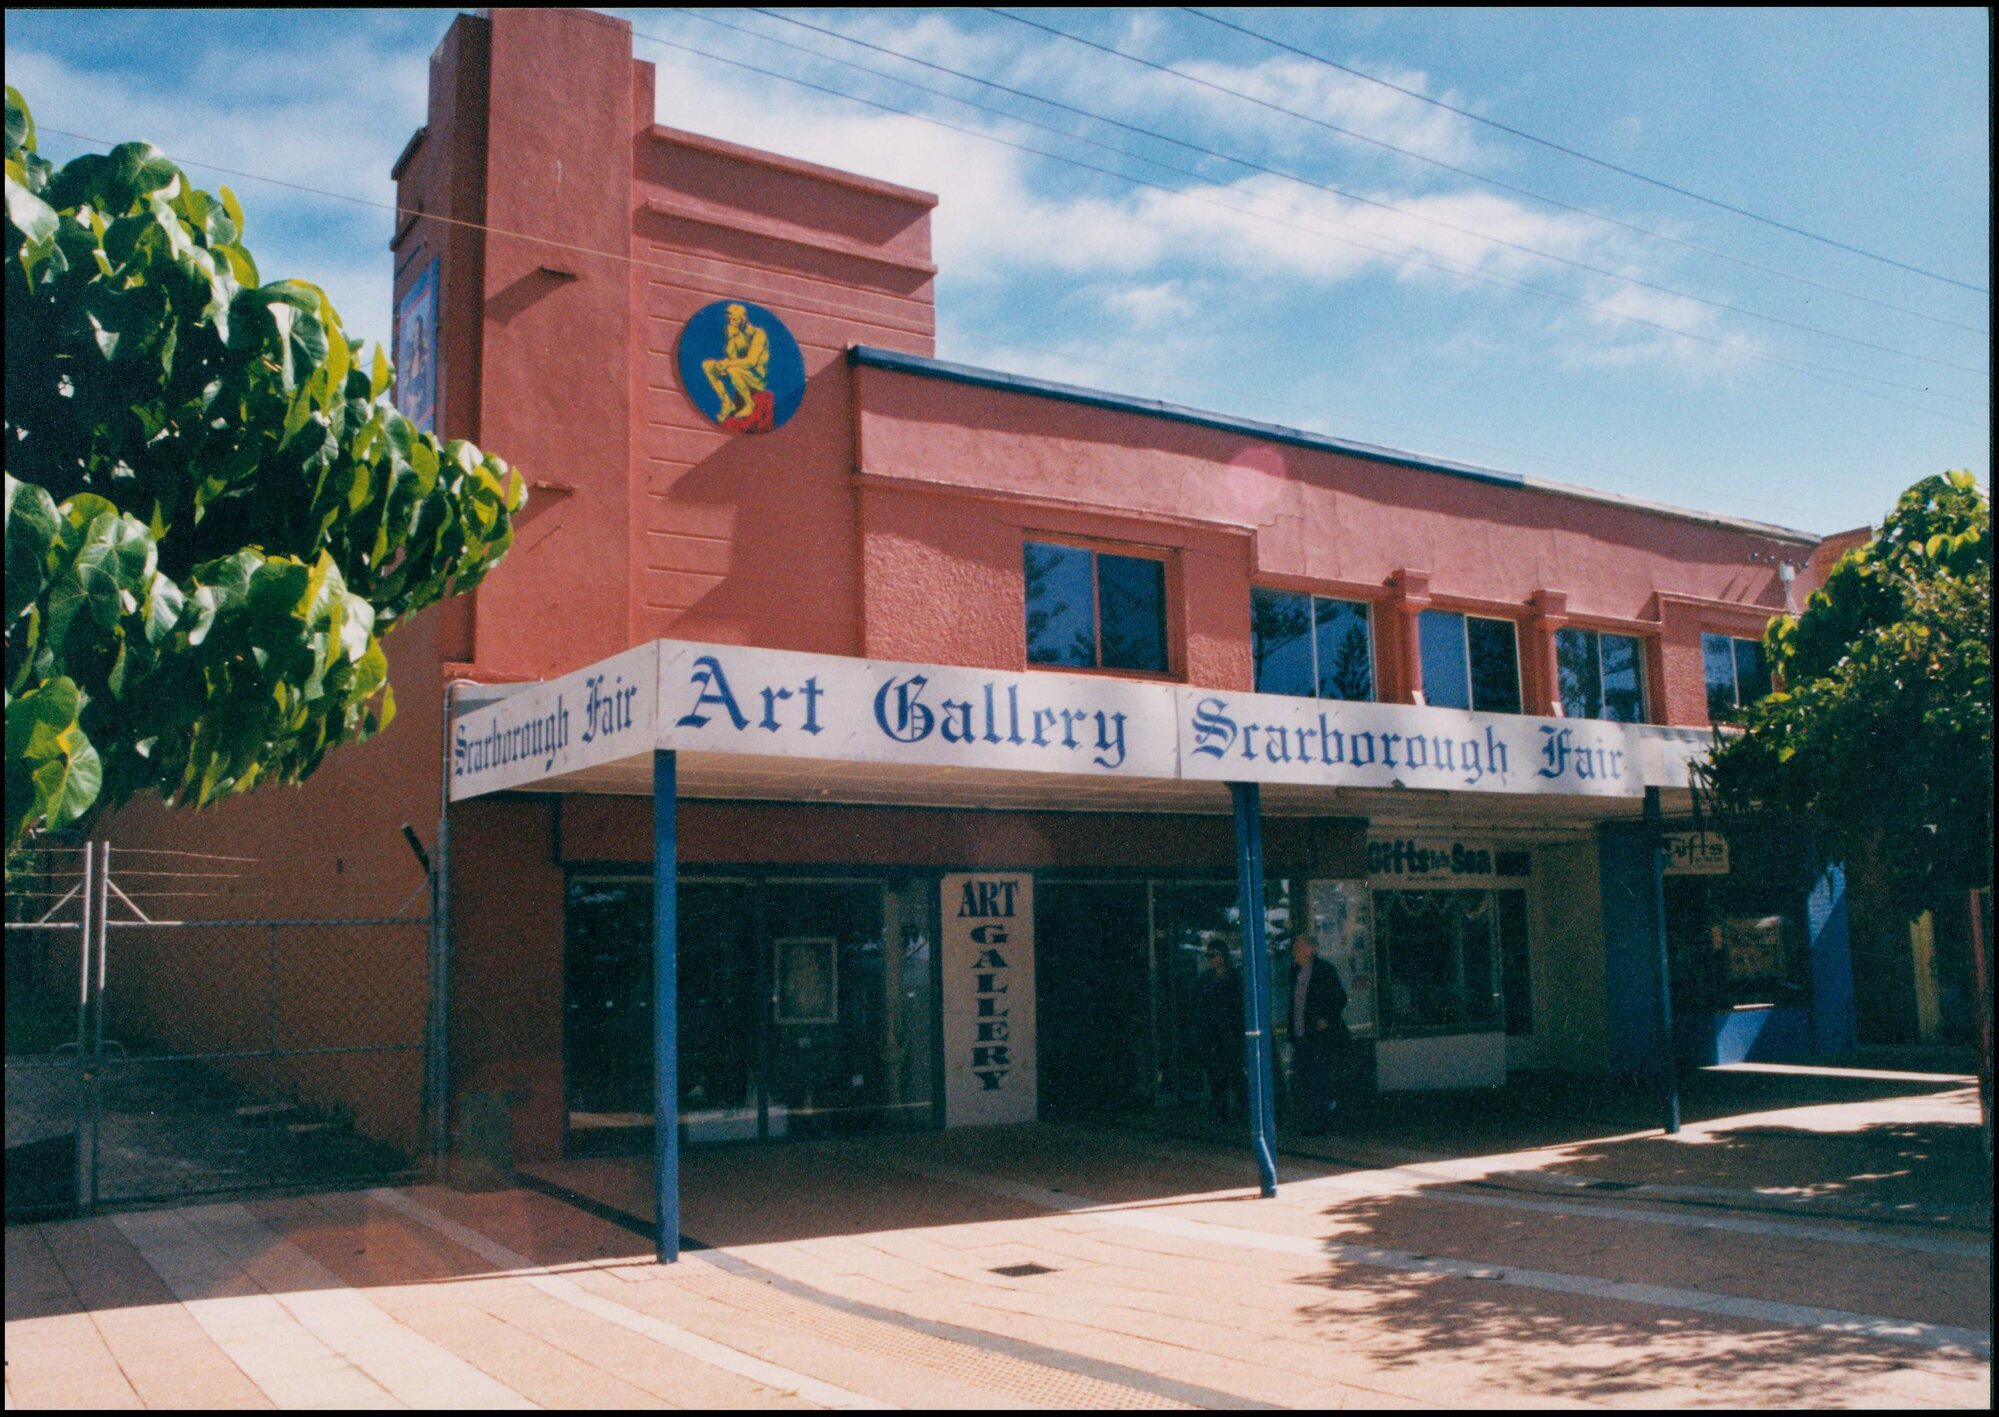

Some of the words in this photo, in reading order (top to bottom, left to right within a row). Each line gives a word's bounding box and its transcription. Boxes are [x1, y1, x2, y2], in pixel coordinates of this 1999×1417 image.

[453, 693, 569, 777] Scarborough
[581, 673, 638, 743] Fair
[675, 654, 825, 736] Art
[873, 673, 1128, 767] Gallery
[1191, 697, 1509, 786] Scarborough
[1537, 725, 1625, 781] Fair
[957, 879, 1019, 918] ART
[1367, 839, 1430, 873] Gifts
[1450, 842, 1493, 874] Sea
[970, 924, 1011, 1091] GALLERY
